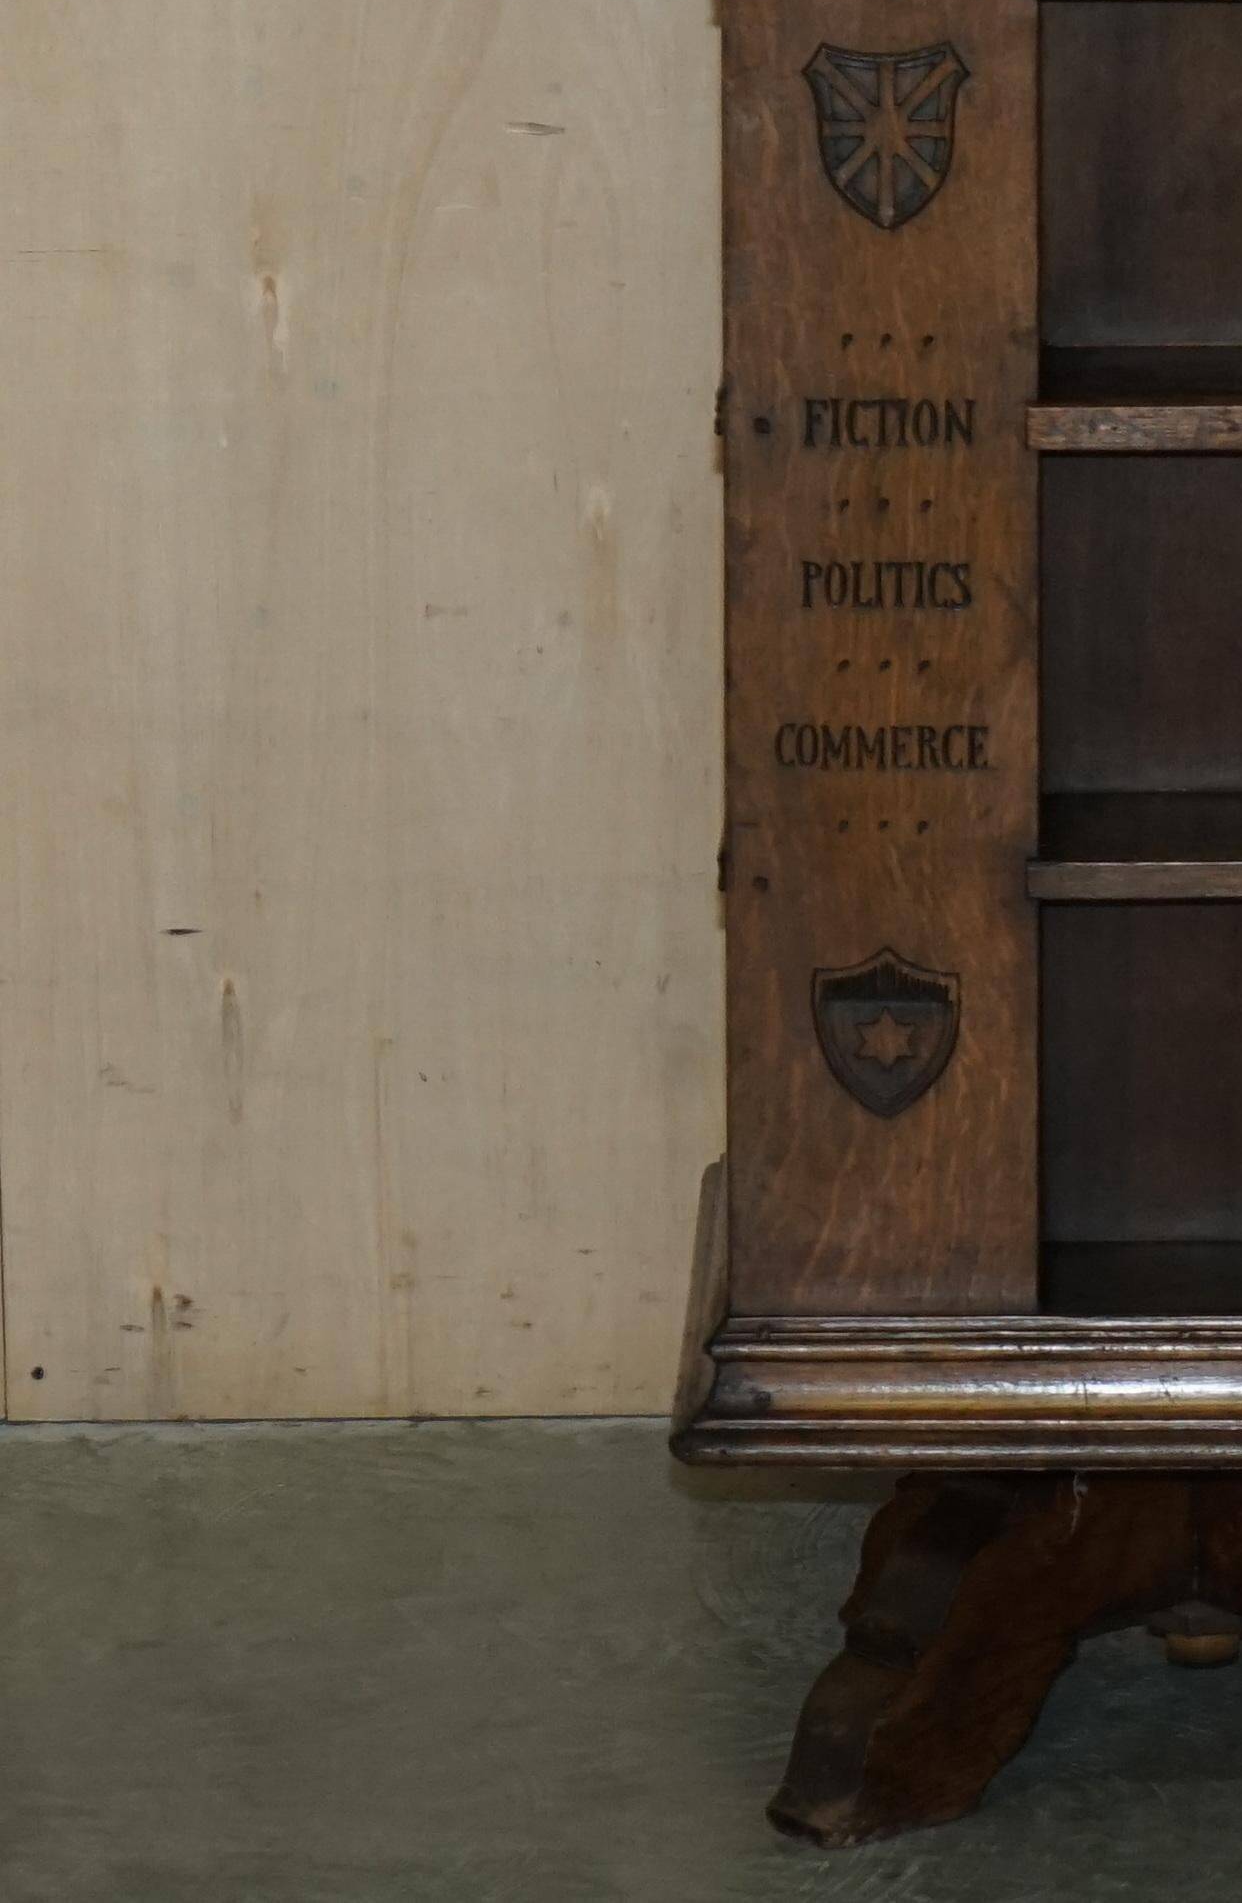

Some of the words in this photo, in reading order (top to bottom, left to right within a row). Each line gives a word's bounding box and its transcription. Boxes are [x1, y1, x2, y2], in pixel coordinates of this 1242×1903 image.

[802, 398, 977, 449] FICTION
[801, 560, 974, 609] POLITICS
[774, 721, 991, 773] COMMERCE
